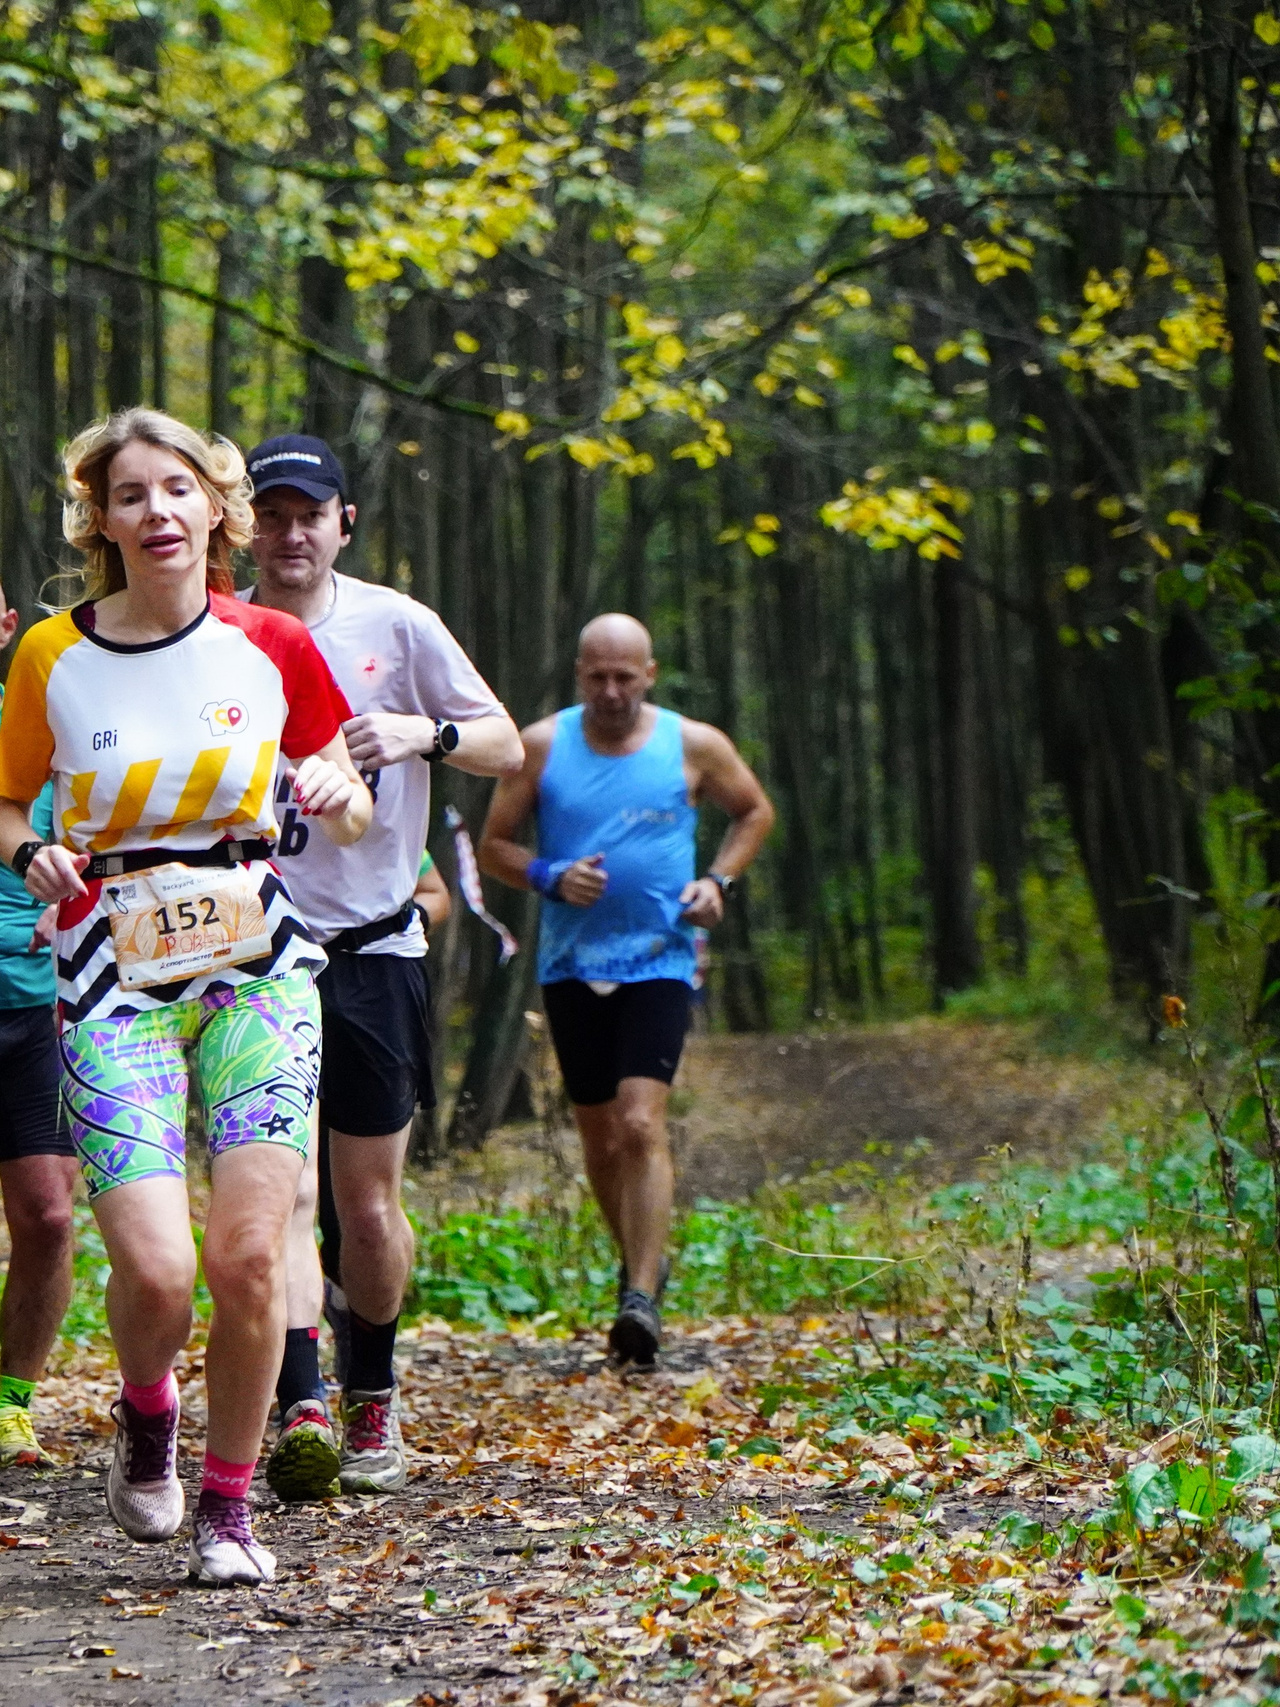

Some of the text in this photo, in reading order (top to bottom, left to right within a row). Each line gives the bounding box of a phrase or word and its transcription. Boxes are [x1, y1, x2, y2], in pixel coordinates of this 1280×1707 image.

[92, 729, 118, 751] GRi
[162, 879, 194, 891] Backyard
[154, 896, 221, 935] 152
